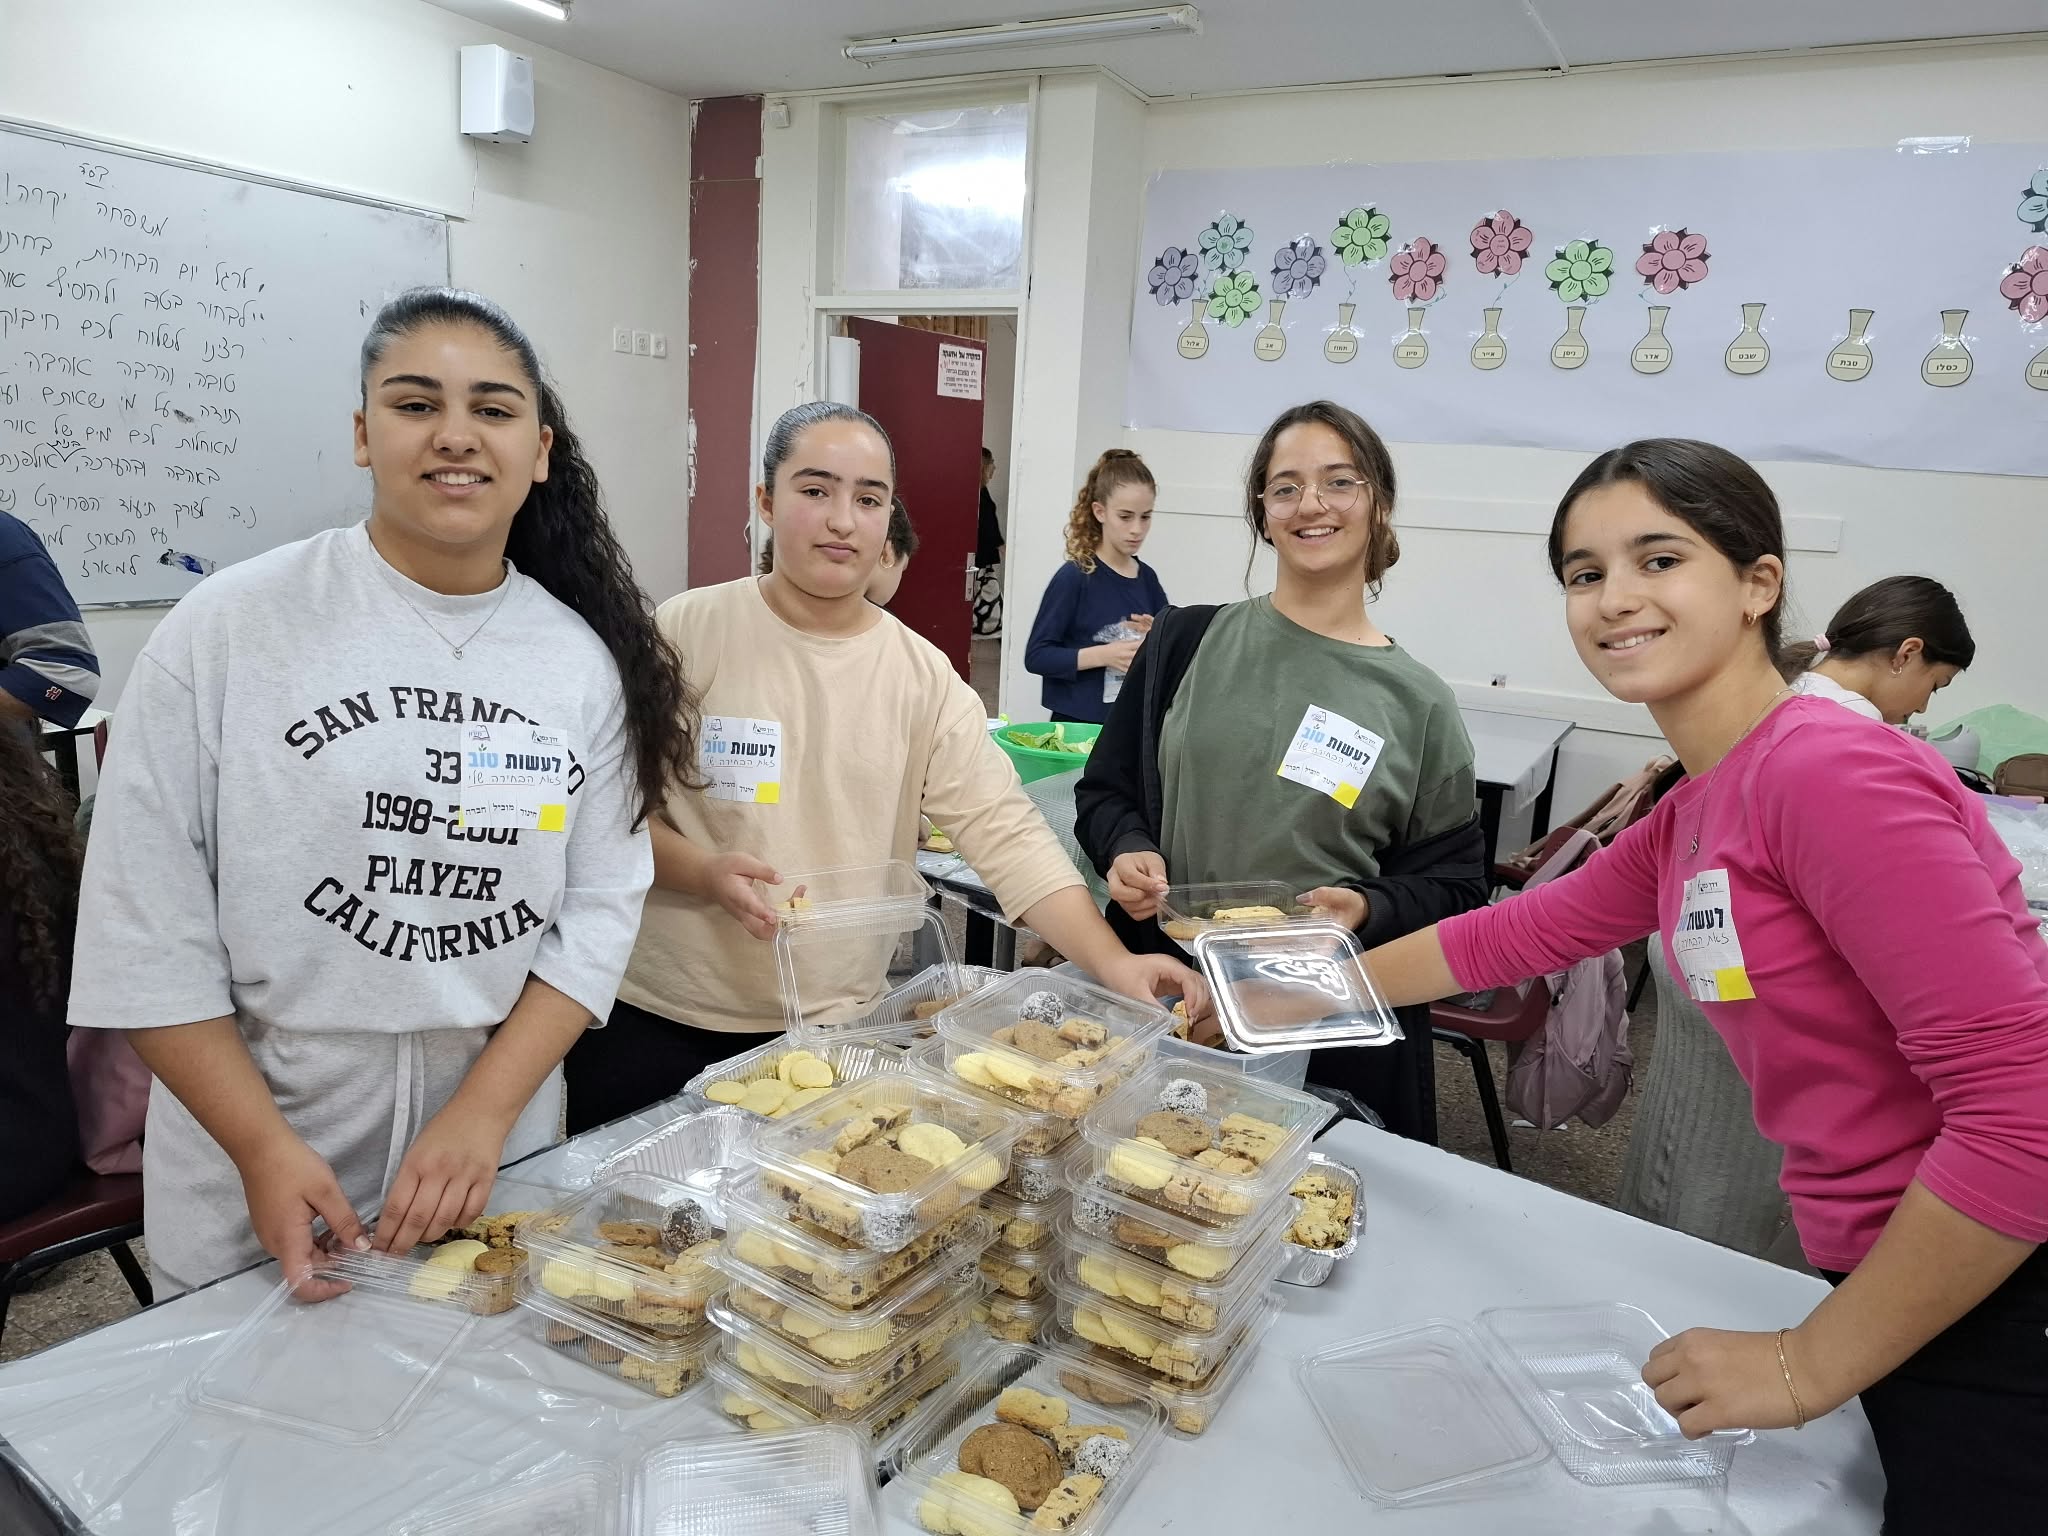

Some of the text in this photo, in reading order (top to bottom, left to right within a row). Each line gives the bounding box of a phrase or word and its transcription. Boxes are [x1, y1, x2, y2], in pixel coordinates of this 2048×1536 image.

[97, 202, 169, 237] משפחה
[179, 262, 198, 281] יום
[215, 261, 254, 292] לרגל
[46, 265, 120, 304] ולהוסיף
[143, 288, 183, 311] בטוב
[80, 313, 125, 340] לכם
[137, 322, 187, 351] לשלוח
[201, 336, 245, 363] רצינו
[1738, 352, 1757, 360] שבט
[116, 361, 175, 386] והרבה
[1839, 359, 1859, 367] טבת
[1936, 363, 1958, 371] כסלו
[42, 386, 105, 409] שאתם
[120, 394, 137, 411] מי
[154, 391, 171, 418] על
[199, 404, 241, 425] תודה
[3, 413, 238, 456] מאחלות לכם ימים של אור
[164, 466, 221, 487] באהבה
[119, 496, 156, 519] תיעוד
[172, 496, 211, 529] לצורך
[83, 529, 136, 554] המארז
[150, 526, 169, 545] עם
[80, 554, 141, 578] למארז
[284, 691, 380, 760] SAN
[704, 740, 776, 757] לעשות טוב
[1301, 727, 1371, 766] לעשות טוב
[1312, 747, 1344, 764] הבחירה
[467, 751, 562, 773] לעשות טוב
[468, 769, 562, 786] זאת הבחירה שלי
[465, 802, 538, 818] חינוך מוביל חברה
[364, 854, 503, 902] PLAYER
[303, 876, 545, 963] CALIFORNIA
